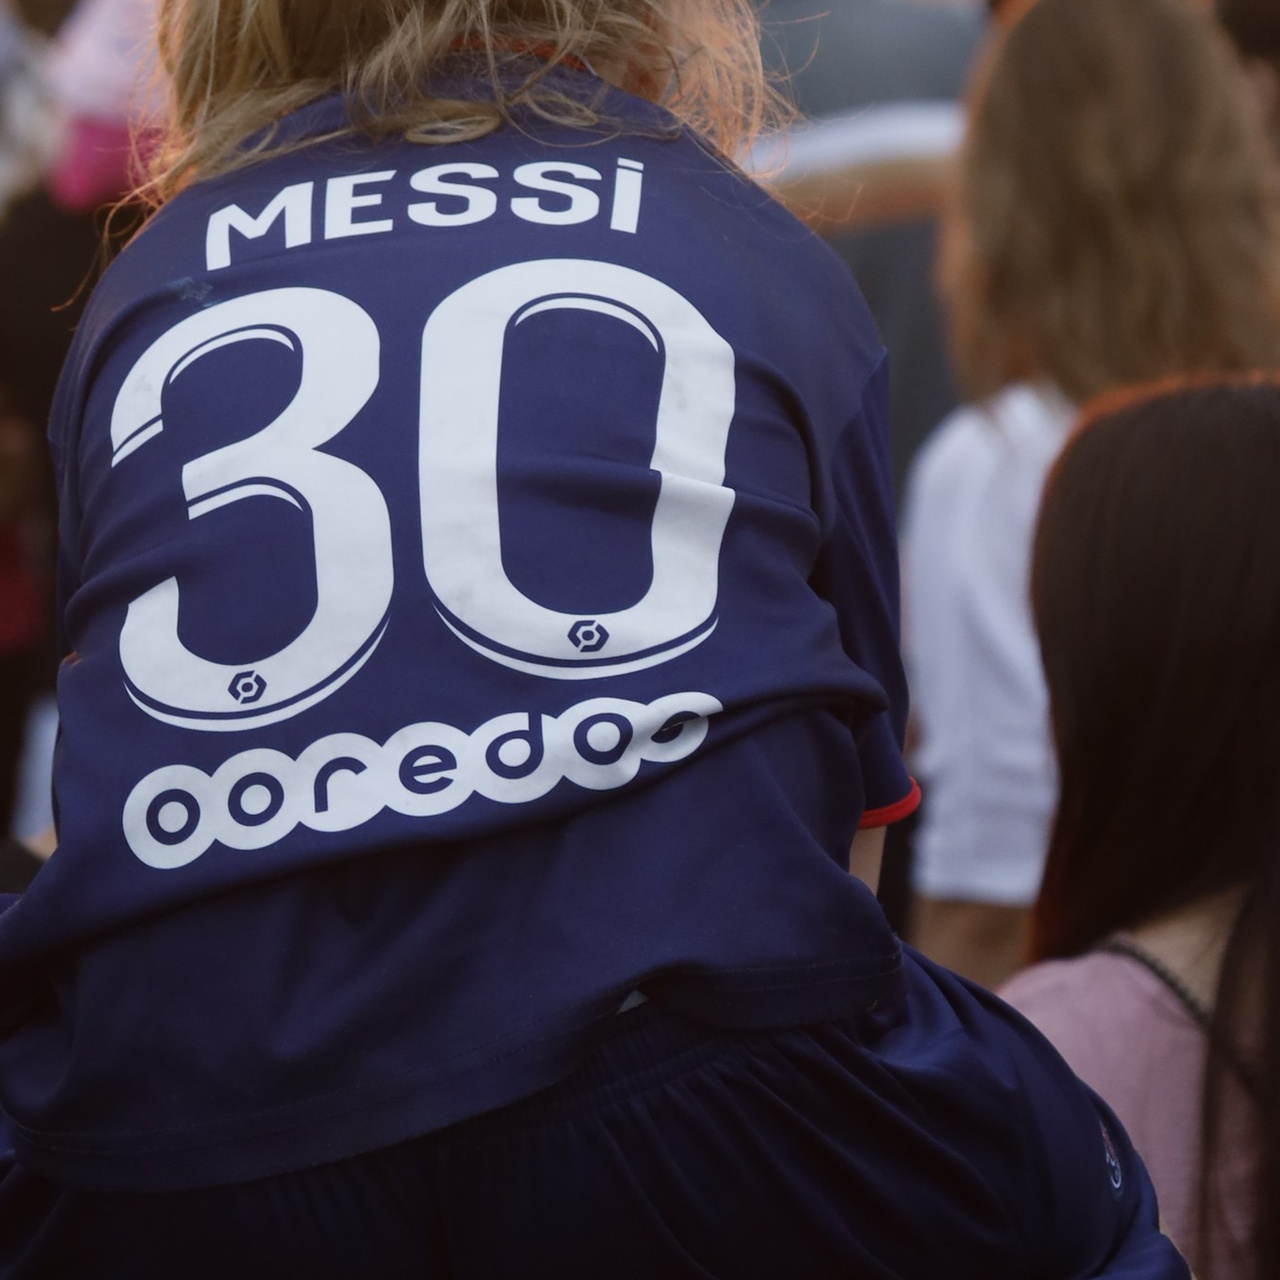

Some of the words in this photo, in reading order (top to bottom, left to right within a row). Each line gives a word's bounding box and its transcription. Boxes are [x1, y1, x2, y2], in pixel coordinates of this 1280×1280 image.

[206, 157, 645, 271] MESSI
[111, 258, 737, 732] 30
[123, 692, 723, 869] ooredoo
